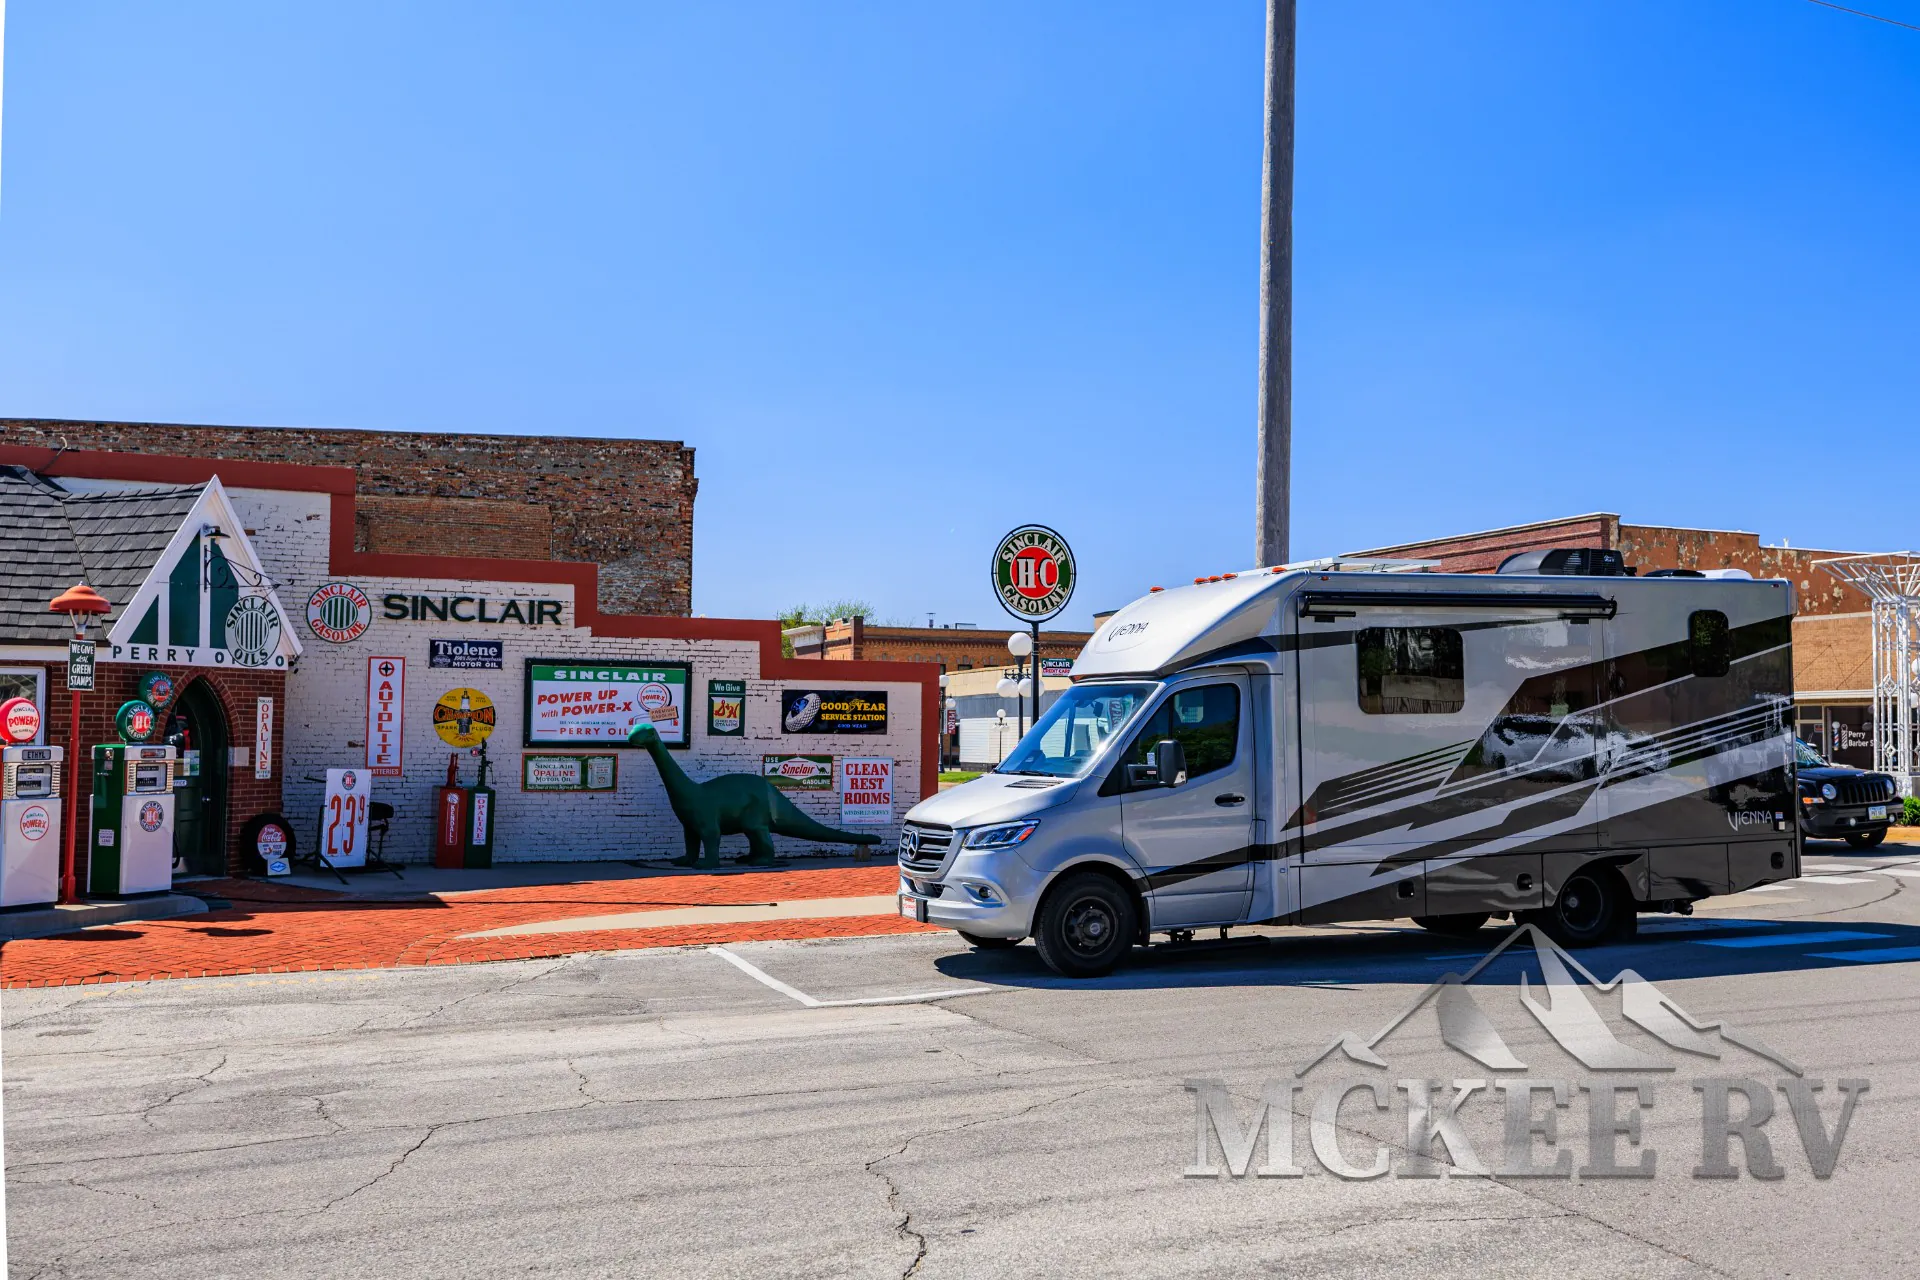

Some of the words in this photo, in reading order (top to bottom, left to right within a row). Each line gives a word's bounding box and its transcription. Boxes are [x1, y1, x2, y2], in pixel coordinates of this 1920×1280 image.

[1001, 533, 1066, 565] SINCLAIR
[311, 585, 367, 609] SINCLAIR
[1003, 583, 1067, 613] GASOLINE
[227, 598, 278, 629] SINCLAIR
[383, 594, 563, 625] SINCLAIR
[311, 618, 366, 641] GASOLINE
[112, 645, 195, 663] PERRY
[435, 641, 498, 656] Tiolene
[234, 648, 268, 665] OILS
[71, 664, 92, 674] GREEN
[1042, 660, 1070, 669] SINCLAIR
[70, 675, 92, 686] STAMPS
[554, 670, 667, 682] SINCLAIR
[714, 683, 725, 691] We
[725, 683, 741, 692] Give
[537, 691, 593, 705] POWER
[597, 689, 618, 701] UP
[128, 705, 154, 719] SINCLAIR
[434, 705, 494, 724] CHAMPION
[541, 709, 559, 718] with
[561, 701, 633, 716] POWER-X
[376, 680, 393, 764] AUTOLITE
[127, 724, 153, 739] GASOLINE
[259, 703, 269, 770] OPALINE
[559, 727, 600, 735] PERRY
[607, 728, 629, 736] OIL
[1848, 731, 1866, 739] Perry
[27, 751, 46, 759] ETHYL
[533, 769, 576, 777] OPALINE
[781, 763, 816, 775] Sinclair
[845, 763, 889, 776] CLEAN
[850, 777, 885, 790] REST
[843, 792, 890, 805] ROOMS
[475, 799, 486, 839] OPALINE
[1727, 810, 1773, 831] VIENNA
